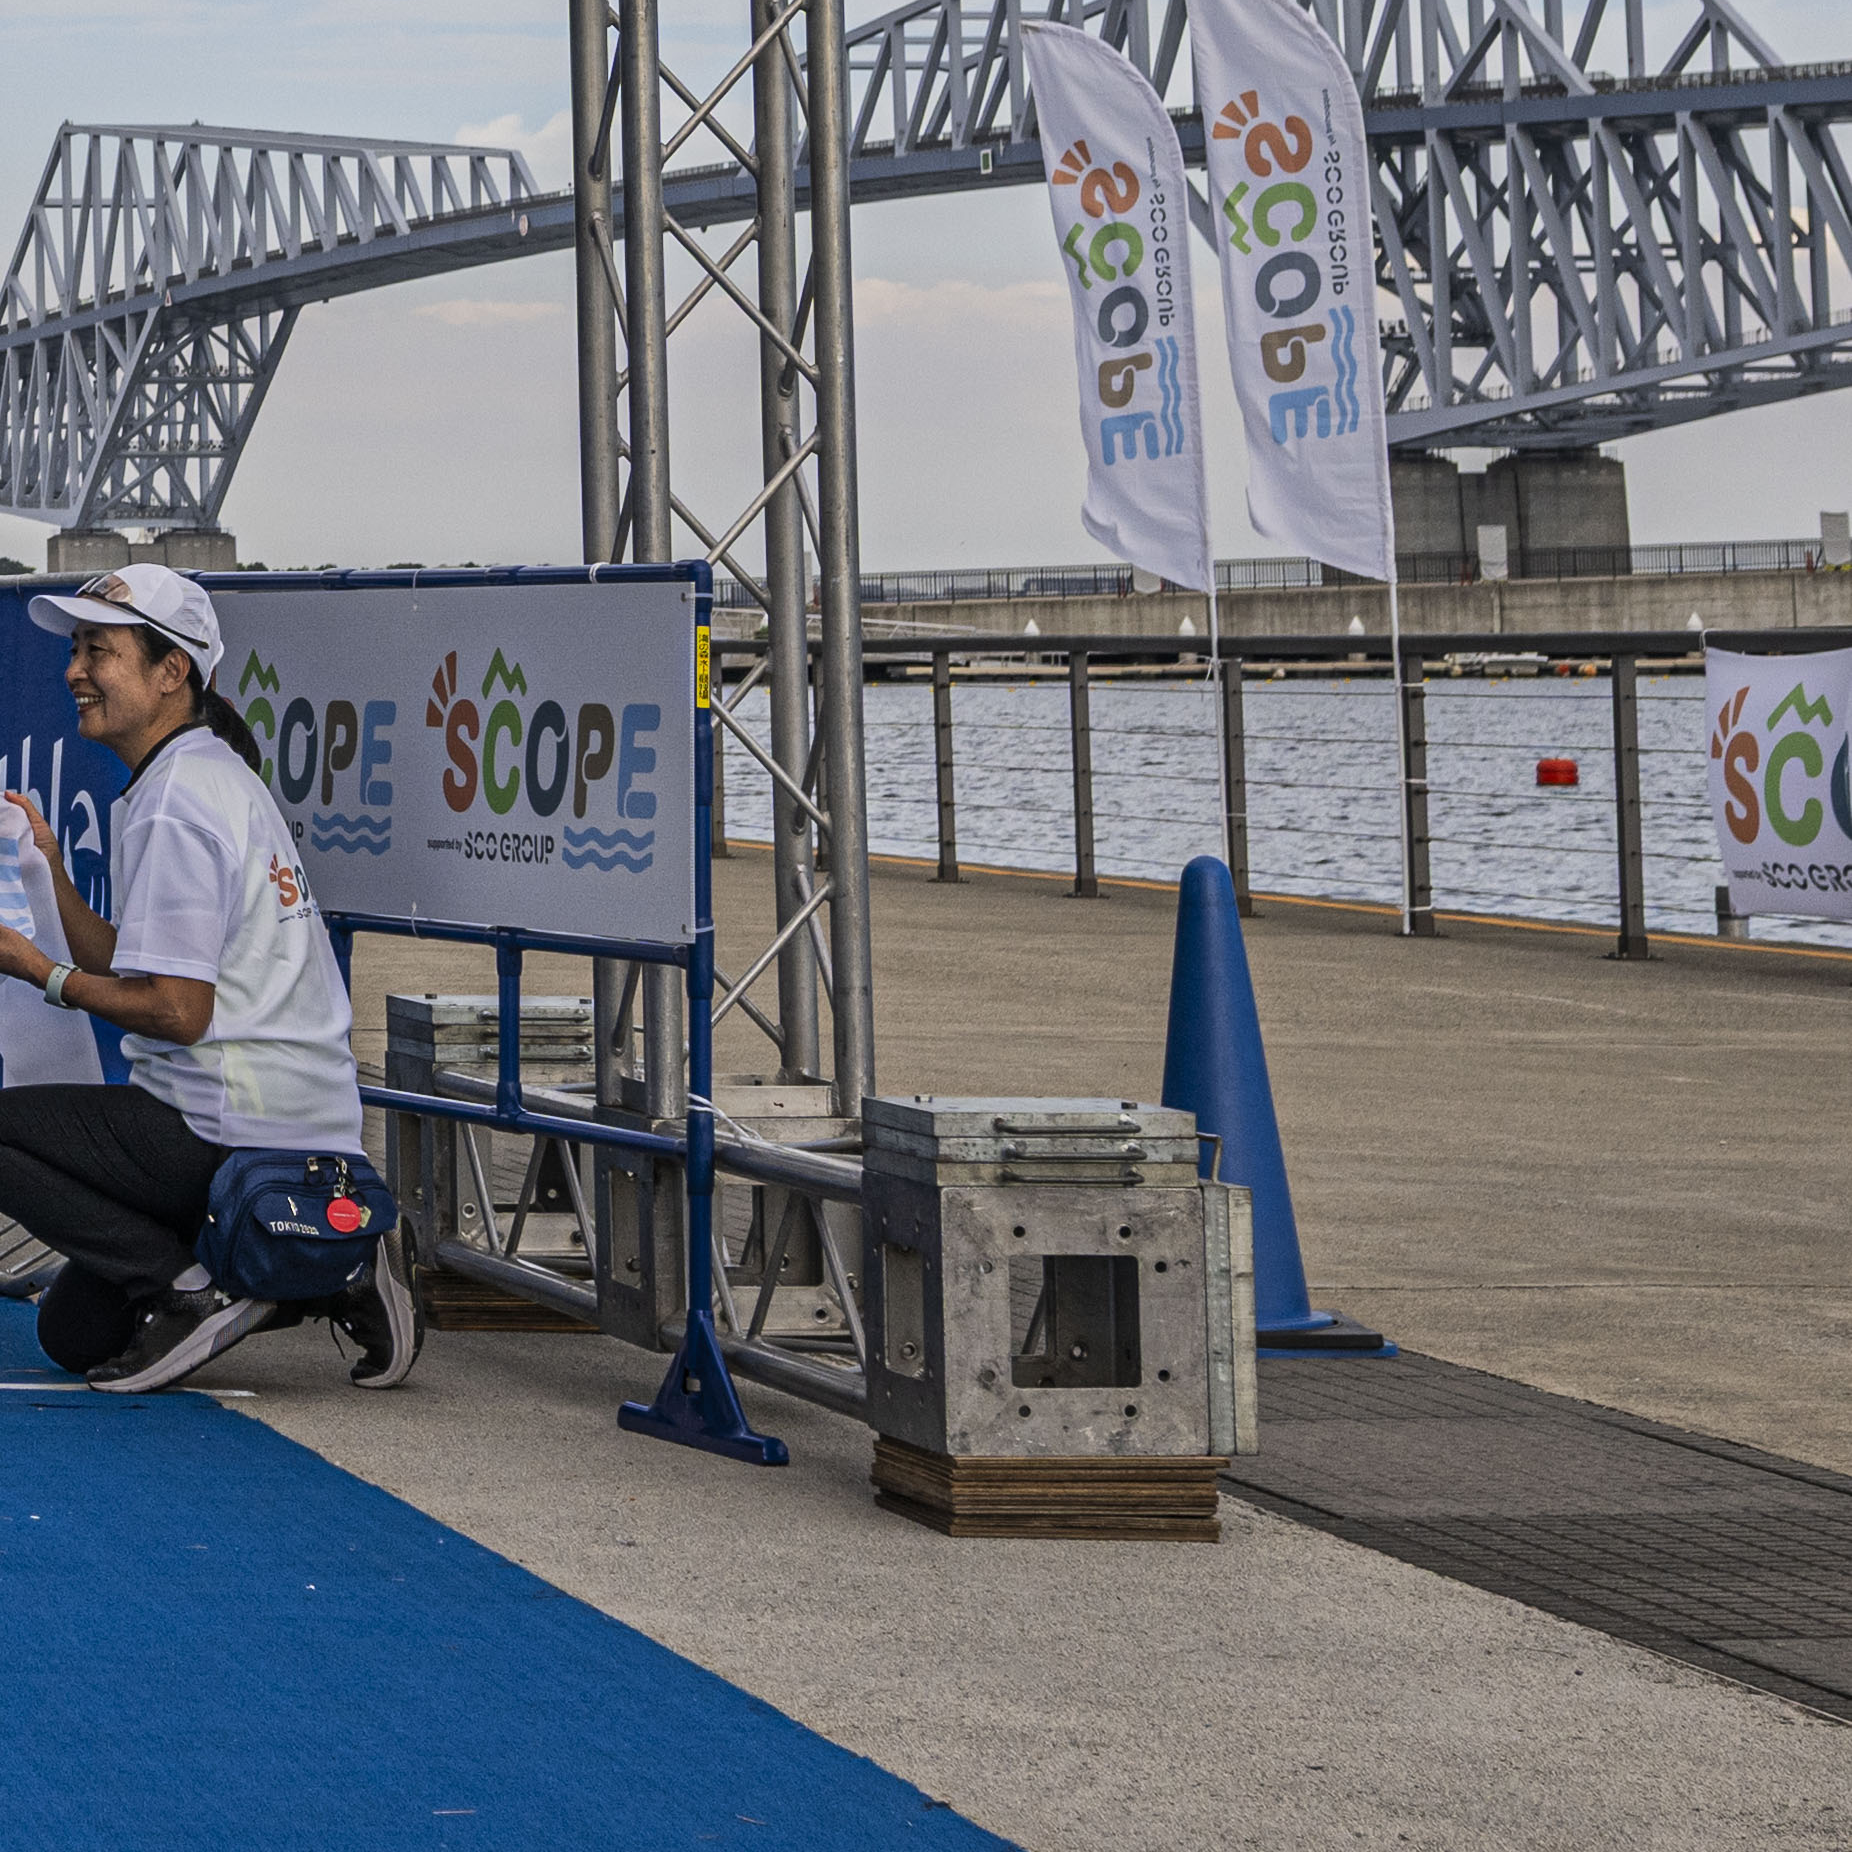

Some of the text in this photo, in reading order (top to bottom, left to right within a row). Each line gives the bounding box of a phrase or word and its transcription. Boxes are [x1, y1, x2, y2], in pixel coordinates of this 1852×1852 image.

[443, 697, 662, 819] SCOPE
[464, 830, 497, 861] SCO
[499, 832, 555, 865] GROUP
[269, 1220, 301, 1234] TOKYO
